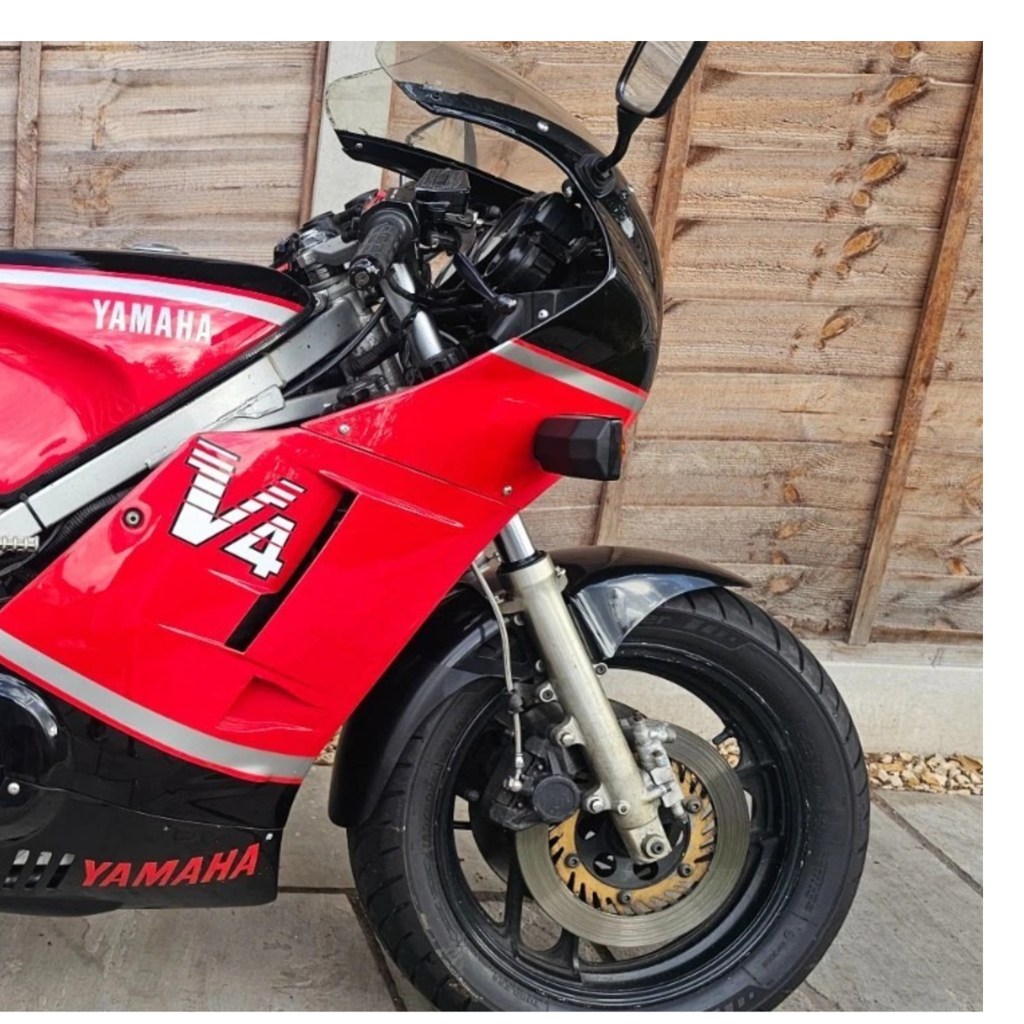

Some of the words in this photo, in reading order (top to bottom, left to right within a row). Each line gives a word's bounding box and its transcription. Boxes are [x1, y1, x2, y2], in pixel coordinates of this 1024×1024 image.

[92, 298, 212, 346] YAMAHA
[168, 436, 308, 580] V4
[82, 842, 261, 888] YAMAHA
